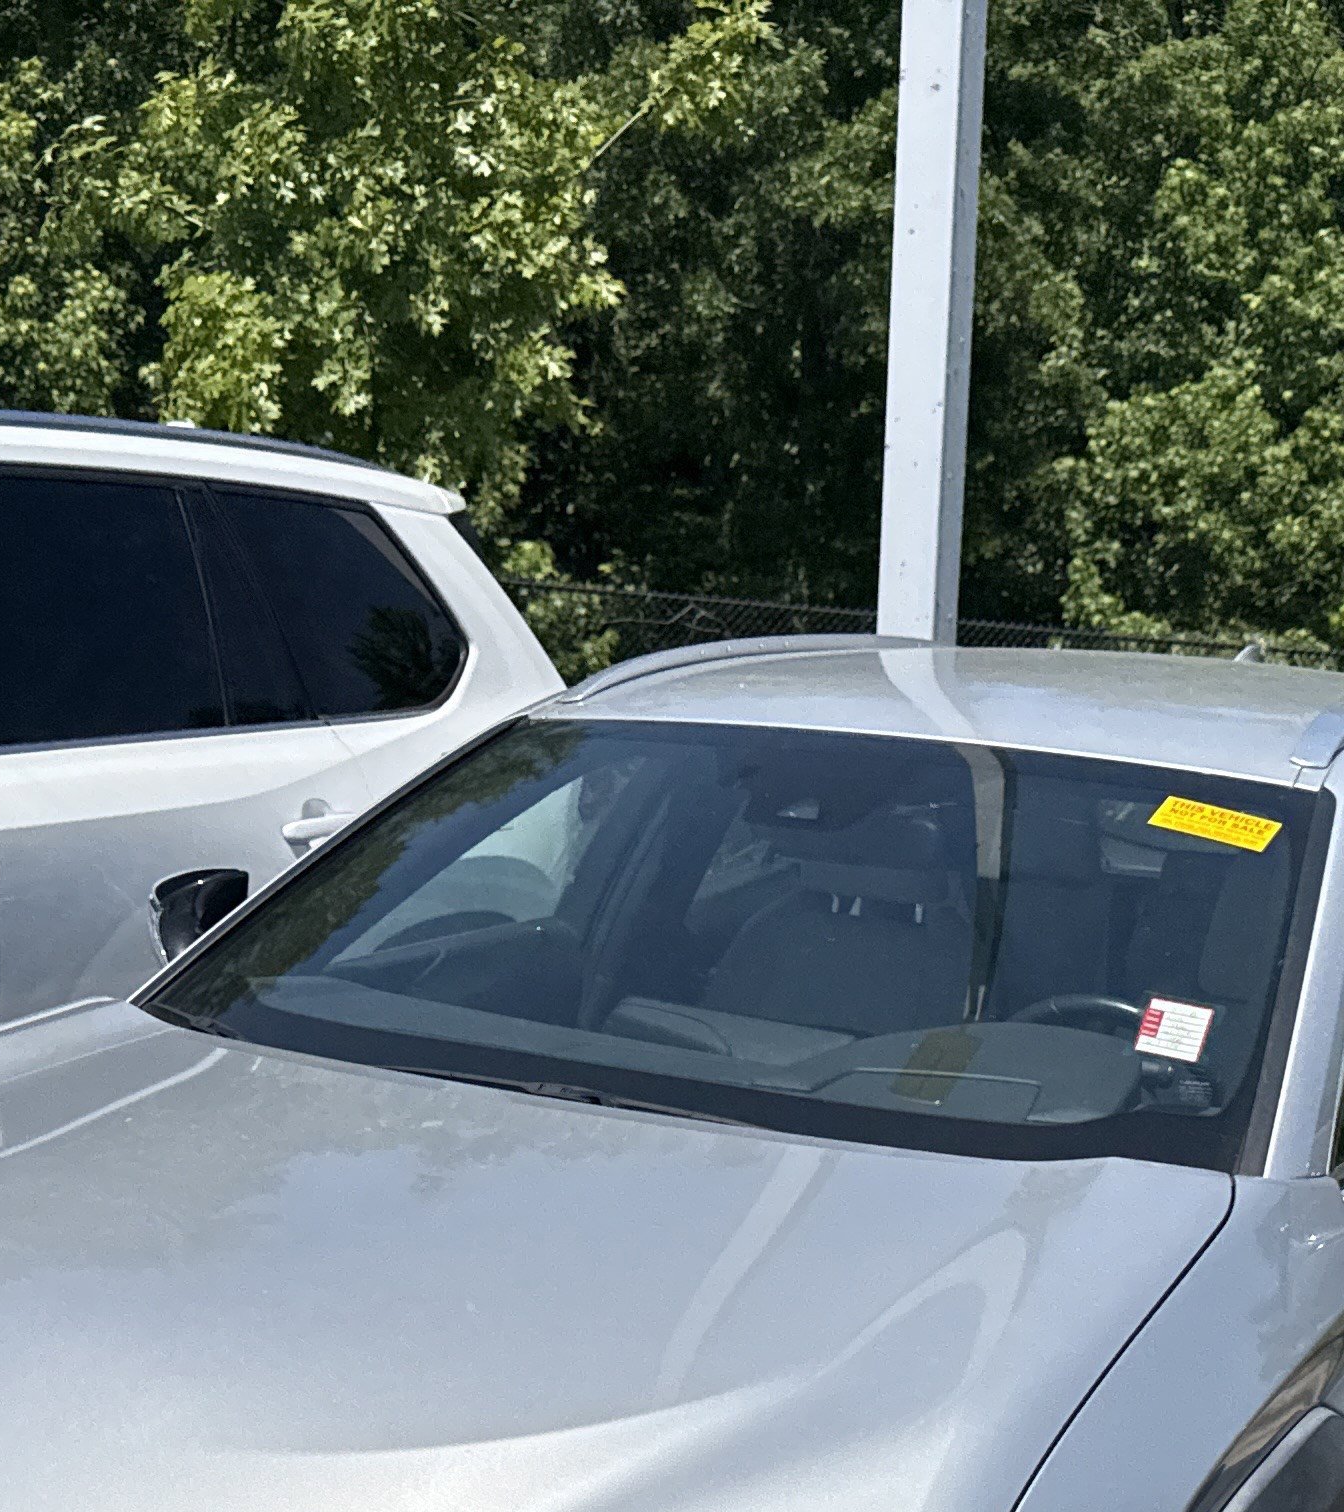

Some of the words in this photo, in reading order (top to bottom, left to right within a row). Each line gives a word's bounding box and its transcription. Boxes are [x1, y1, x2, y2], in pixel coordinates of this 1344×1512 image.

[1169, 807, 1197, 818] NOT
[1199, 814, 1228, 827] FOR
[1231, 822, 1266, 836] SALE
[1172, 800, 1206, 814] THIS
[1210, 809, 1275, 831] VEHICLE
